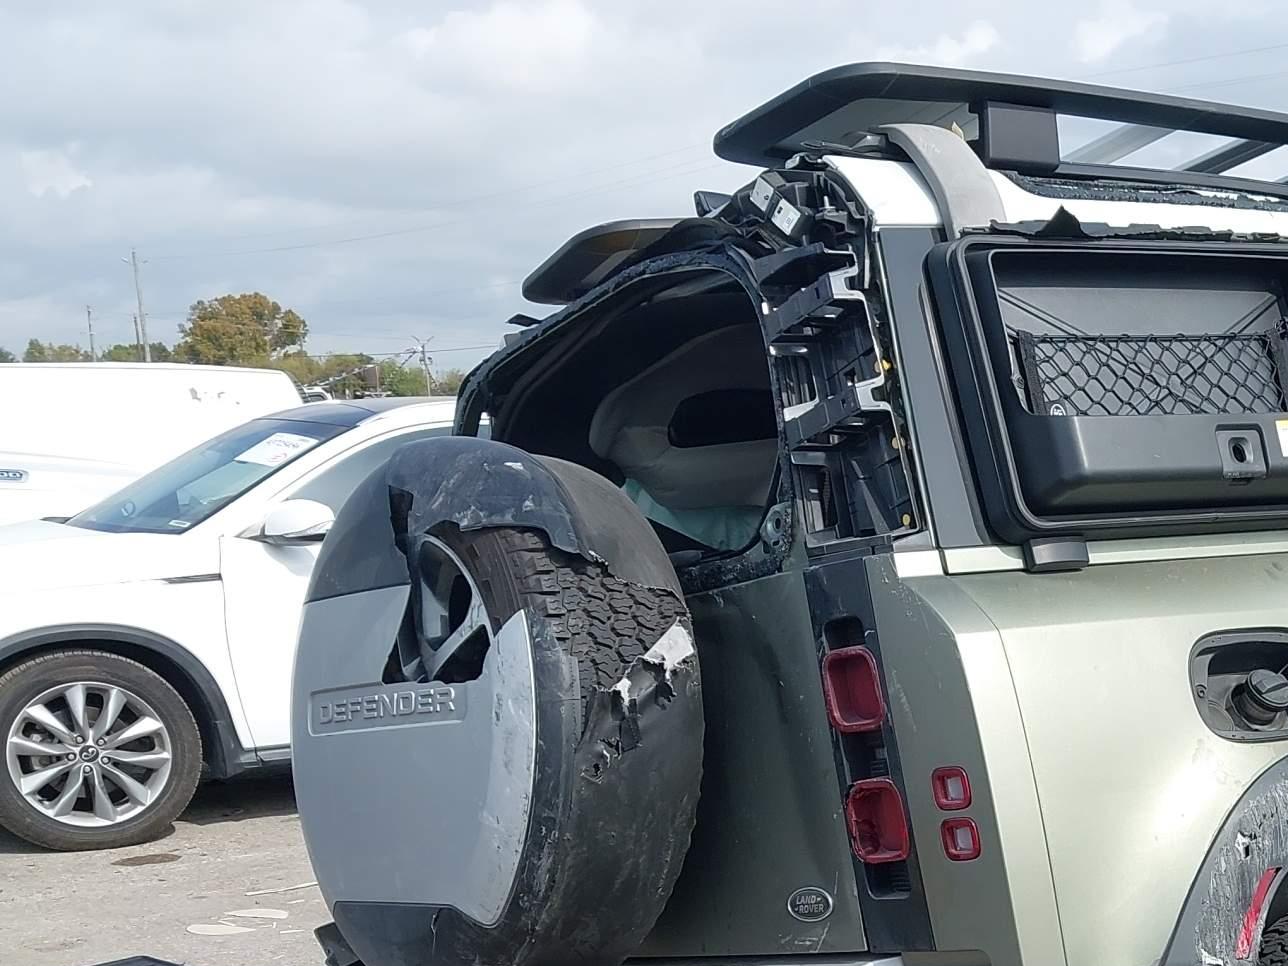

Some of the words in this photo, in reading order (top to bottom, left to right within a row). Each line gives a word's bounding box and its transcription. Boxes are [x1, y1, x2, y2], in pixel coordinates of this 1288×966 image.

[319, 686, 456, 725] DEFENDER
[796, 895, 817, 905] LAND
[799, 903, 825, 914] ROVER
